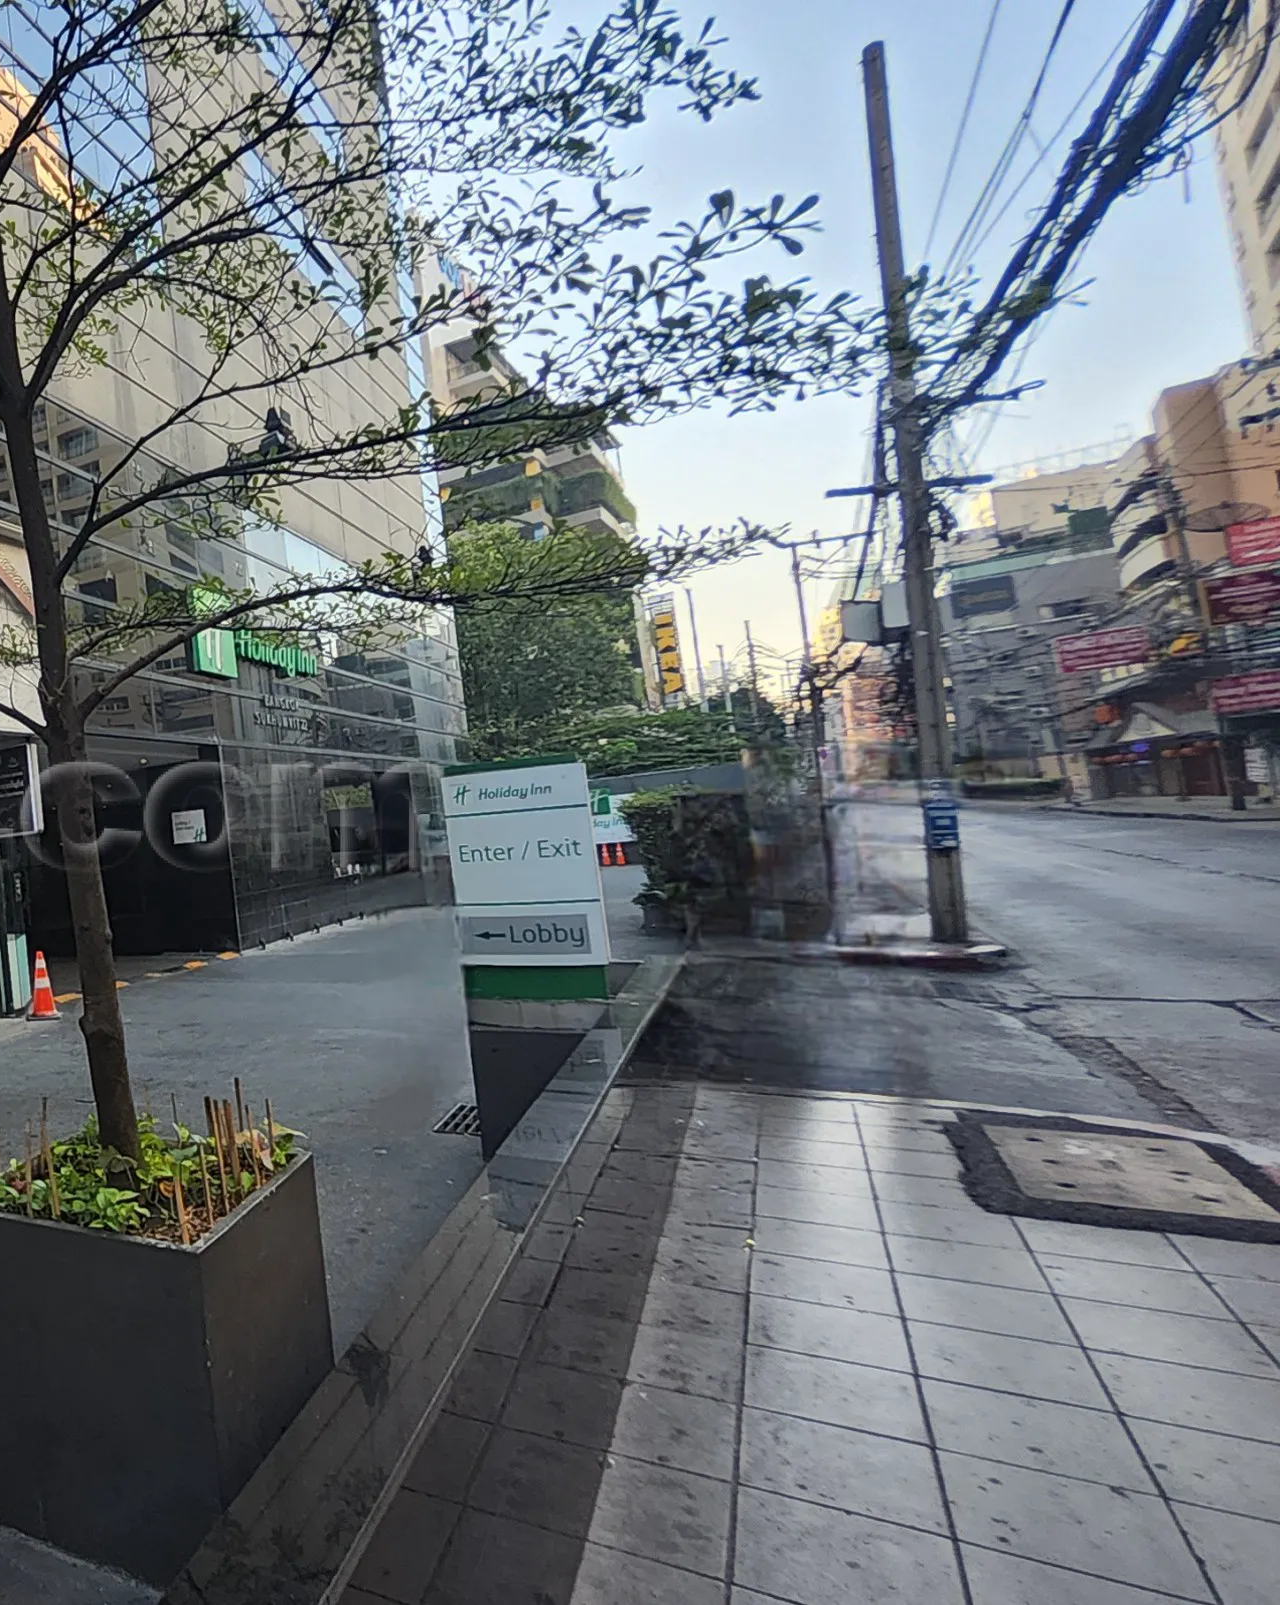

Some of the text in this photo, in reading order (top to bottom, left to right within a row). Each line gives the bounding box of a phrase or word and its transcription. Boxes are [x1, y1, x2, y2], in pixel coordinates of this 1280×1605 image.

[298, 645, 318, 677] Inn
[479, 785, 528, 801] Holiday
[530, 783, 552, 796] Inn
[459, 838, 582, 863] Enter / Exit
[509, 923, 585, 948] Lobby
